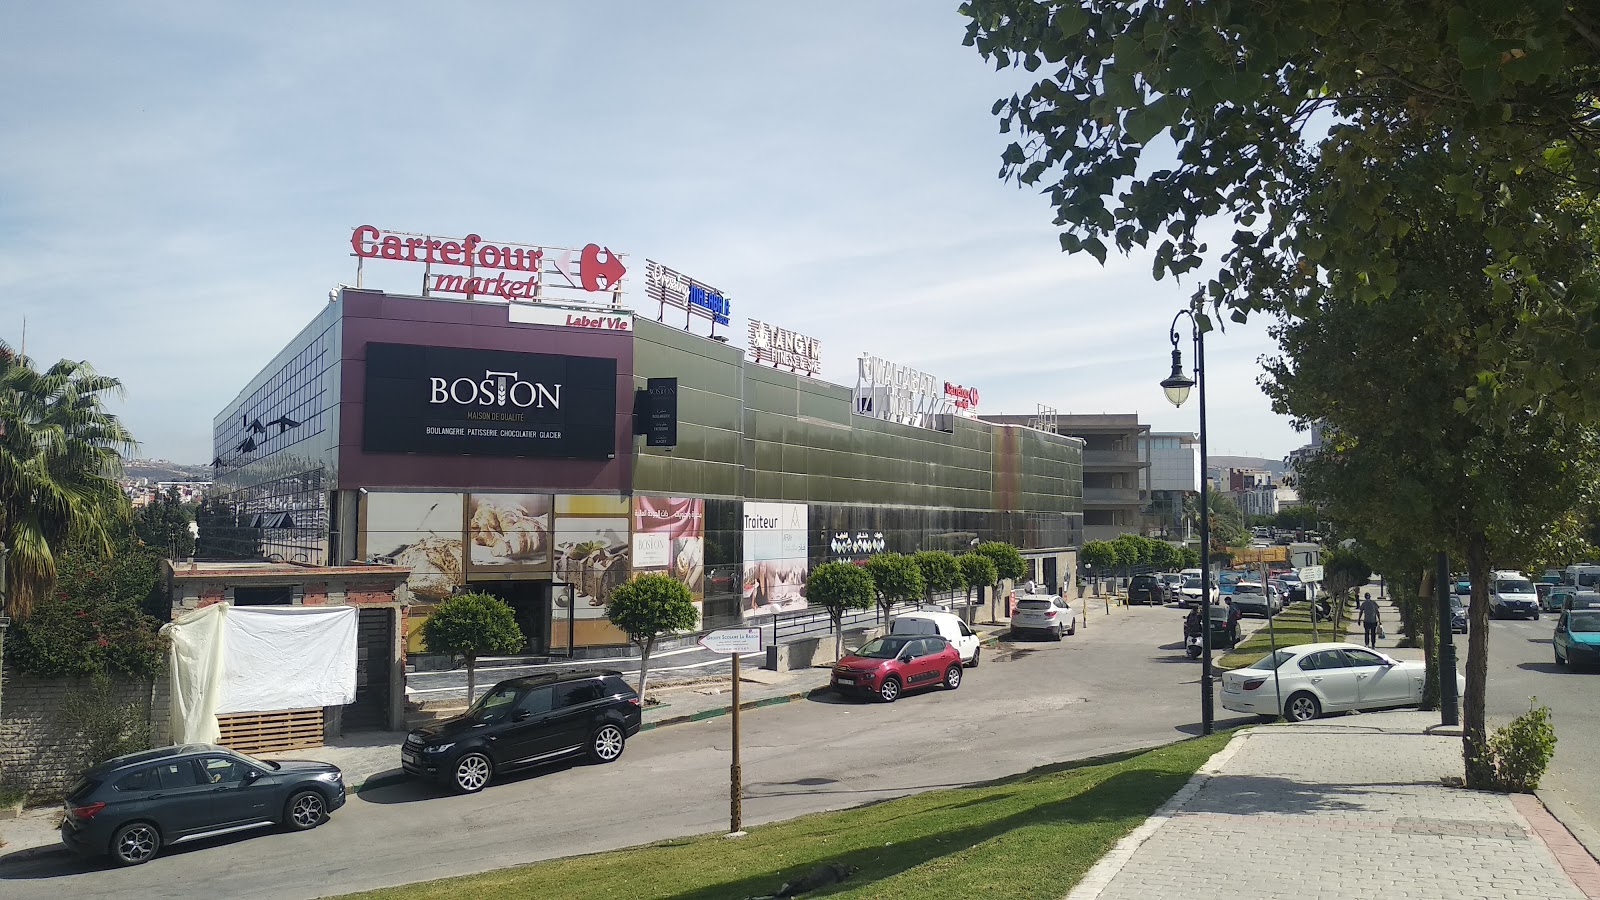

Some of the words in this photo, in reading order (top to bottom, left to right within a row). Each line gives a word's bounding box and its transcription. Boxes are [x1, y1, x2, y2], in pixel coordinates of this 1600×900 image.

[351, 224, 543, 272] Carrefour
[433, 271, 538, 300] market
[651, 263, 691, 306] Pressing
[769, 325, 821, 360] TANGYM
[429, 369, 562, 410] BOSTON
[467, 411, 490, 420] MAISON
[491, 412, 499, 421] DE
[500, 413, 524, 421] QUALITÉ
[426, 427, 465, 435] BOULANGERIE
[467, 428, 498, 437] PATISSERIE
[500, 430, 537, 438] CHOCOLATIER
[540, 431, 562, 439] GLACIER
[744, 514, 778, 529] Traiteur
